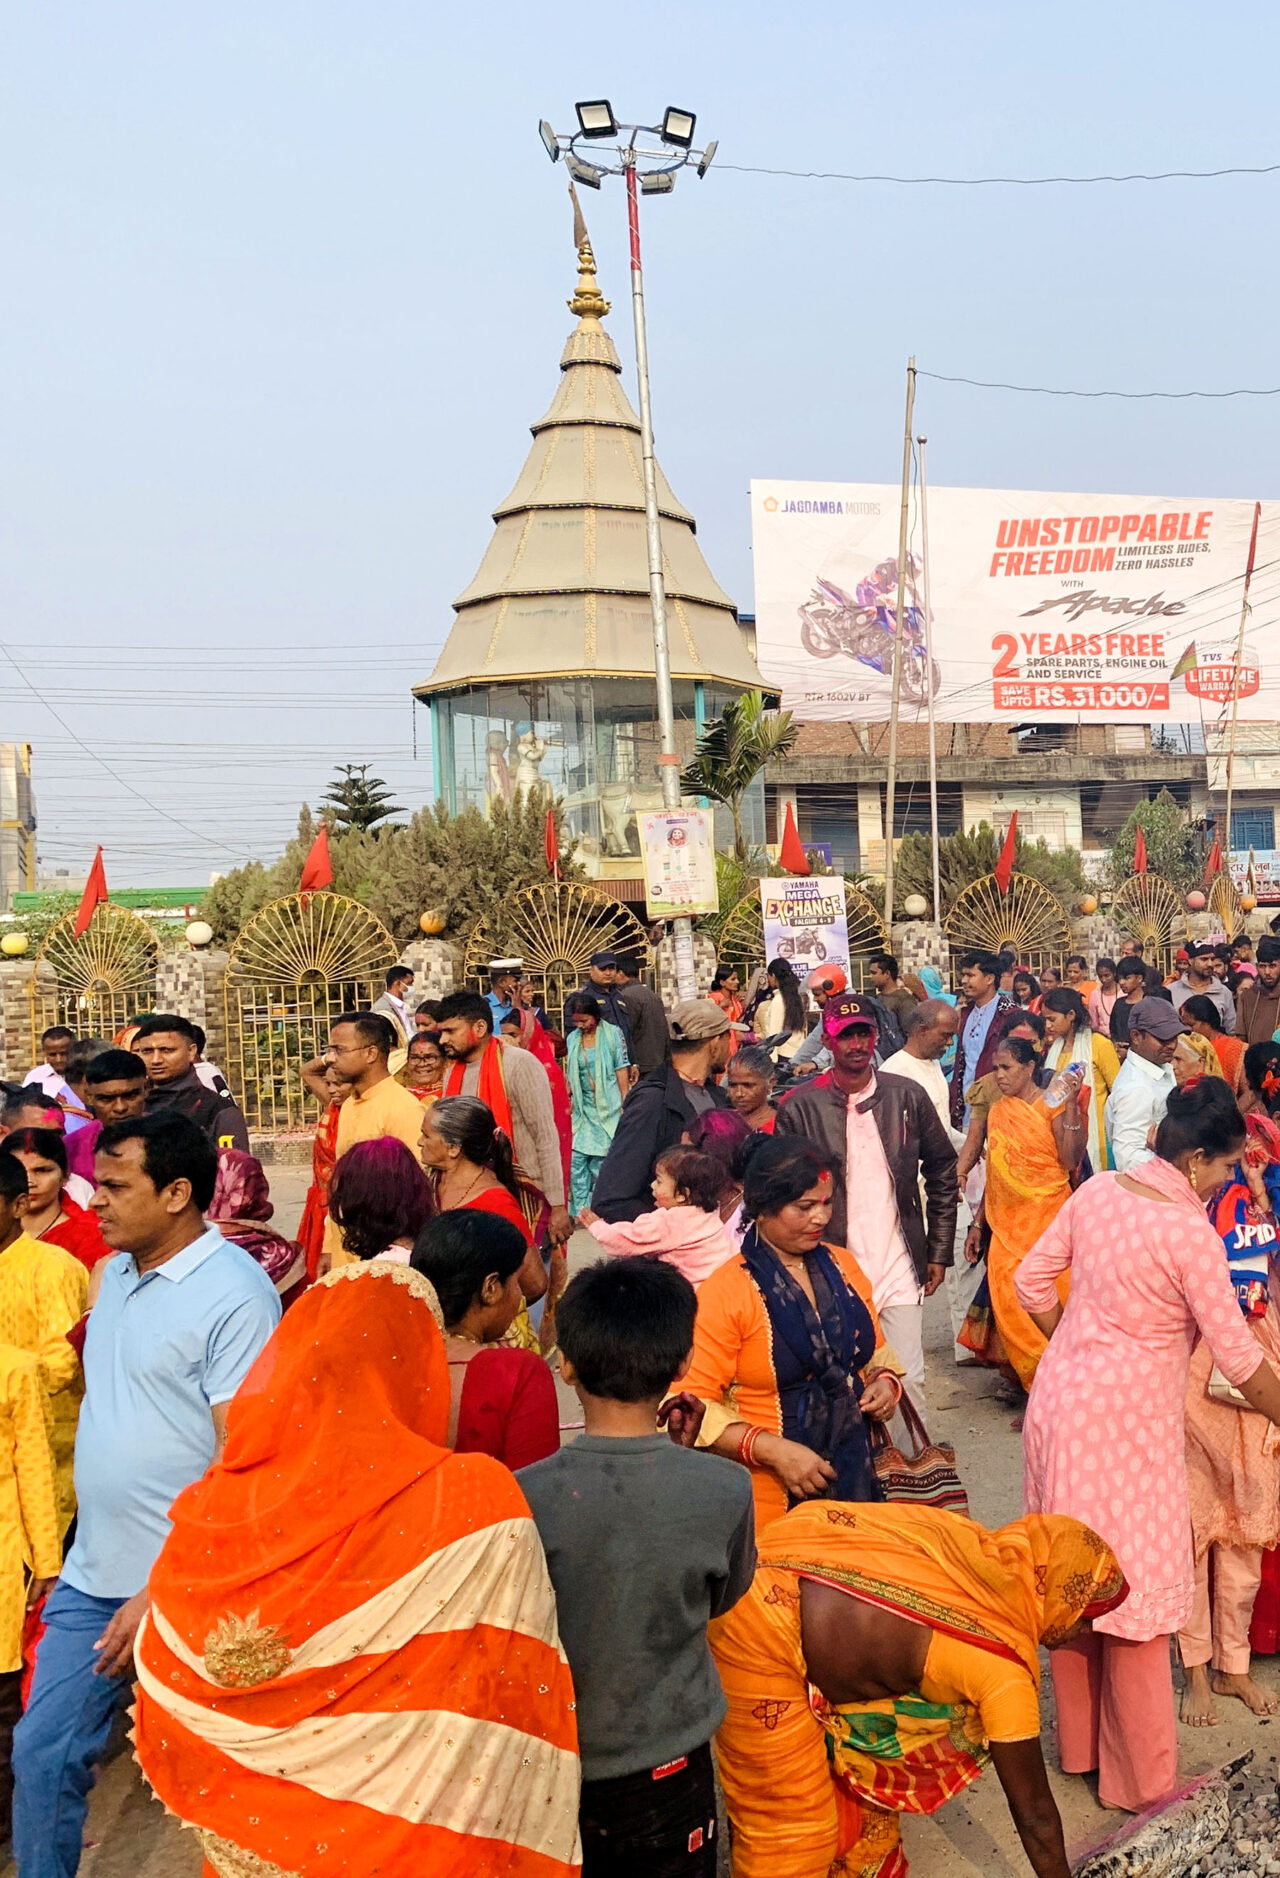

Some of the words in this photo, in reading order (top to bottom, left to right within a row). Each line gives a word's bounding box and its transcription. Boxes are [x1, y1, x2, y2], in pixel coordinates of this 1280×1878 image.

[781, 500, 843, 514] JAGDAMBA
[845, 502, 881, 515] MOTORS
[995, 511, 1213, 548] UNSTOPPABLE
[1117, 545, 1174, 557] LIMITLESS
[1176, 542, 1211, 554] RIDES,
[989, 547, 1117, 577] FREEDOM
[1115, 559, 1143, 571] ZERO
[1145, 557, 1194, 569] HASSLES
[1060, 580, 1084, 588] WITH
[1017, 589, 1192, 623] Apache
[990, 632, 1020, 678] 2
[1020, 633, 1101, 656] YEARS
[1202, 653, 1222, 662] TVS
[1026, 658, 1062, 668] SPARE
[1064, 658, 1104, 669] PARTS,
[1105, 658, 1147, 669] ENGINE
[1149, 658, 1168, 669] OIL
[1026, 670, 1052, 679] AND
[1054, 669, 1102, 679] SERVICE
[1001, 685, 1031, 696] SAVE
[1001, 696, 1033, 706] UPTO
[790, 881, 819, 889] YAMAHA
[786, 891, 820, 899] MEGA
[765, 895, 844, 926] EXCHANGE
[840, 1003, 860, 1015] SD
[1233, 1223, 1277, 1250] SPID
